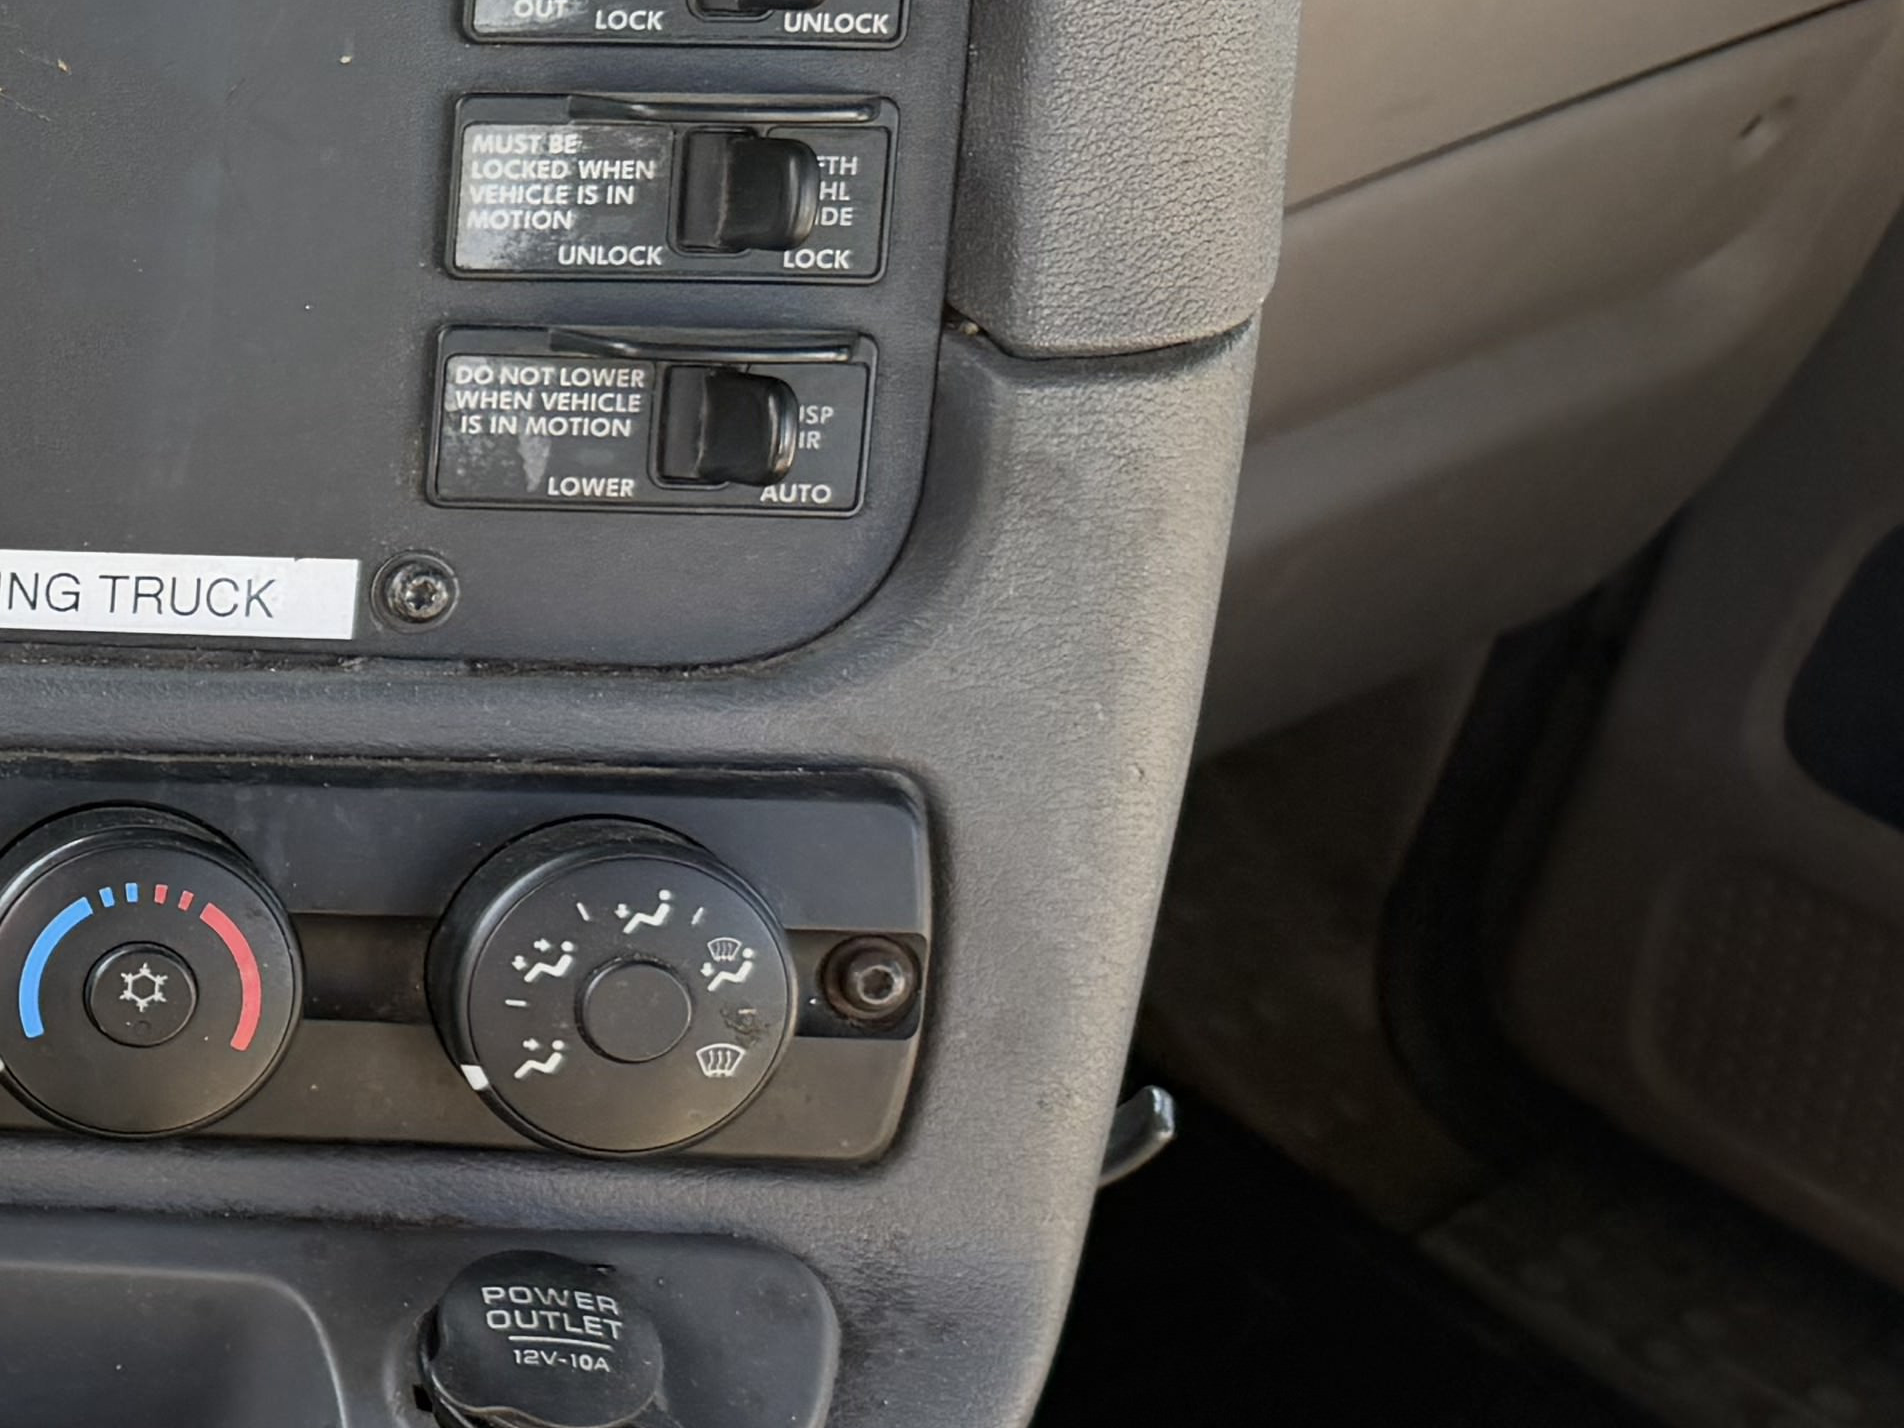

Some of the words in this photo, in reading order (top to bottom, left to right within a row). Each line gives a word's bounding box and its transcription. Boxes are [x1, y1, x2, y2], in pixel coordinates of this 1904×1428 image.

[595, 10, 664, 31] LOCK
[783, 12, 889, 34] UNLOCK
[472, 133, 542, 154] MUST
[549, 134, 577, 154] BE
[470, 159, 570, 180] LOCKED
[578, 159, 656, 180] WHEN
[470, 184, 569, 205] VEHICLE
[577, 184, 597, 205] IS
[606, 184, 636, 205] IN
[819, 181, 850, 201] HL
[468, 209, 574, 231] MOTION
[558, 245, 663, 266] UNLOCK
[783, 248, 851, 270] LOCK
[455, 366, 493, 386] DO
[500, 365, 555, 387] NOT
[559, 367, 646, 389] LOWER
[456, 390, 534, 411] WHEN
[542, 391, 641, 413] VEHICLE
[461, 414, 482, 434] IS
[490, 414, 520, 435] IN
[525, 415, 632, 438] MOTION
[798, 430, 821, 450] IR
[547, 475, 636, 498] LOWER
[761, 484, 832, 504] AUTO
[99, 574, 277, 621] TRUCK
[482, 1286, 620, 1316] POWER
[486, 1309, 623, 1340] OUTLET
[513, 1348, 611, 1372] 12V-10A
